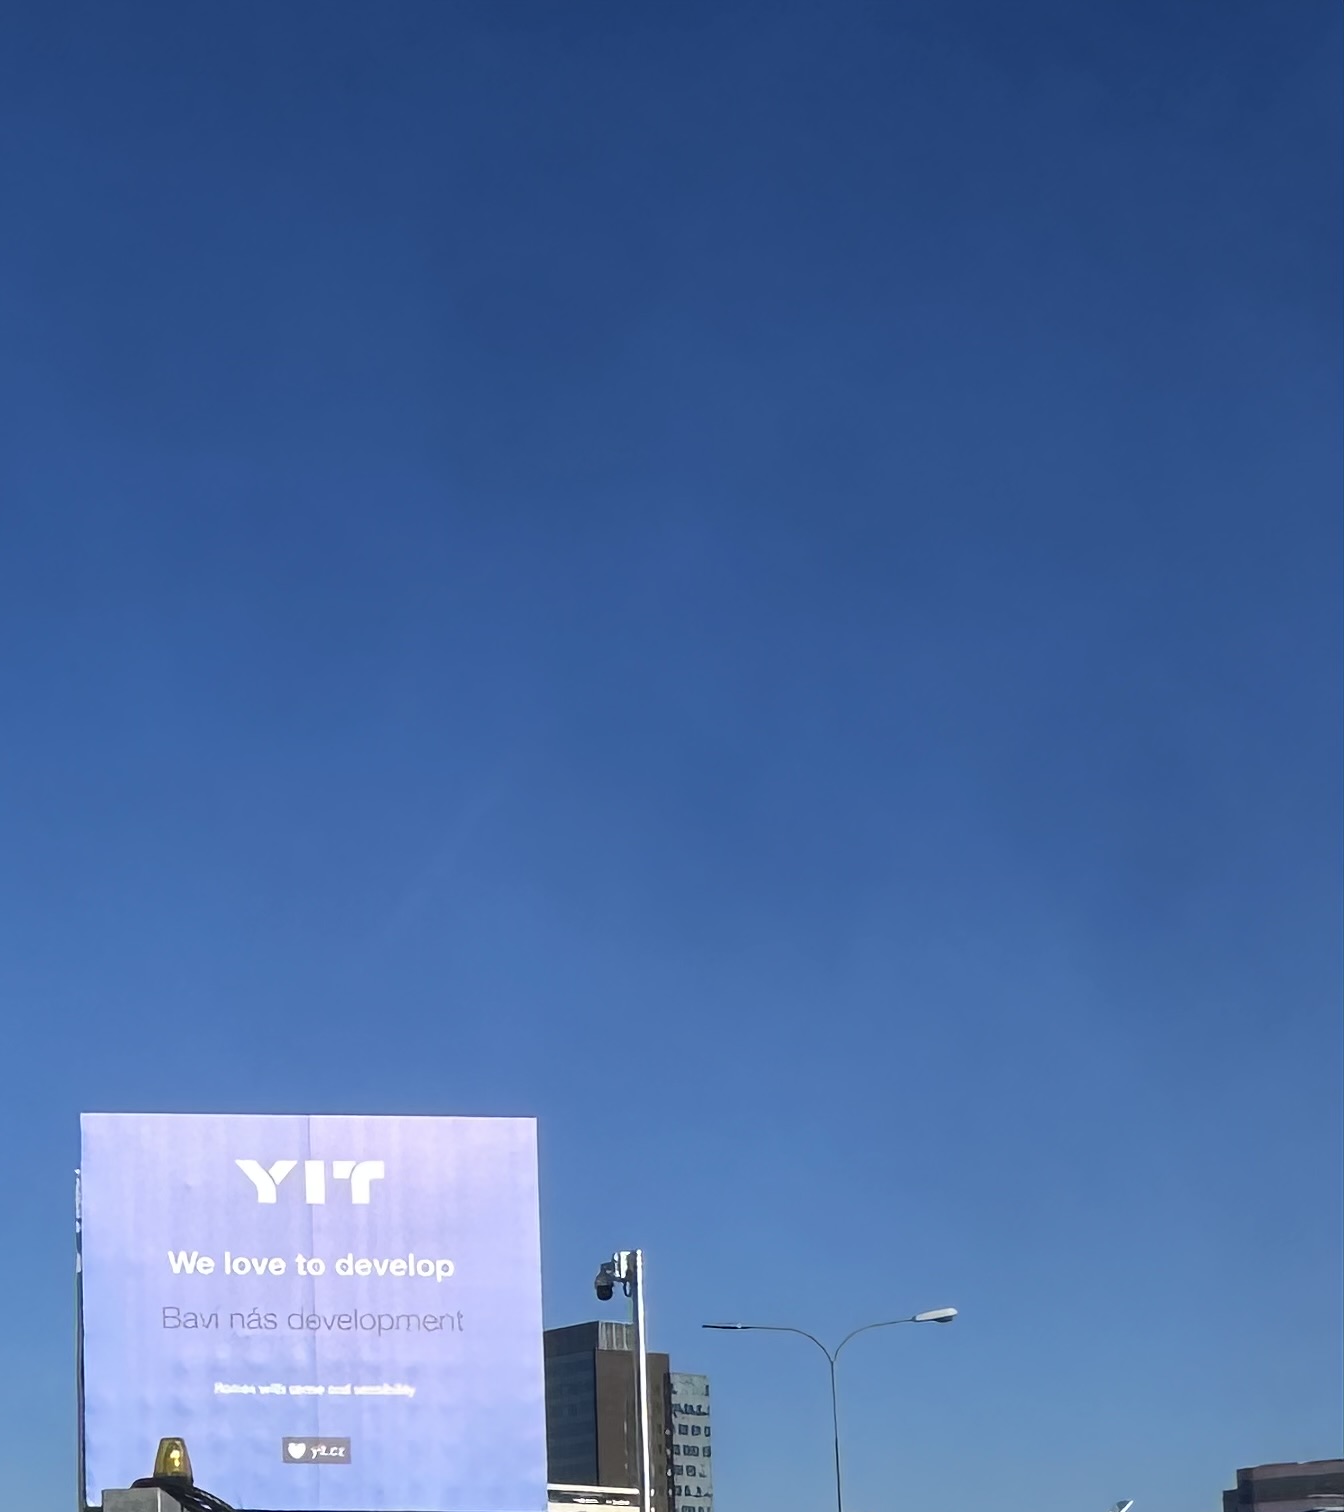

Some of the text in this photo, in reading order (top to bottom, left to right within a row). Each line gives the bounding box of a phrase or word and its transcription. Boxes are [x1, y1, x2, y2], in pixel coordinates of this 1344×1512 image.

[234, 1159, 385, 1204] YIT
[167, 1250, 455, 1283] We love to develop
[229, 1306, 278, 1330] nás
[287, 1306, 464, 1336] development
